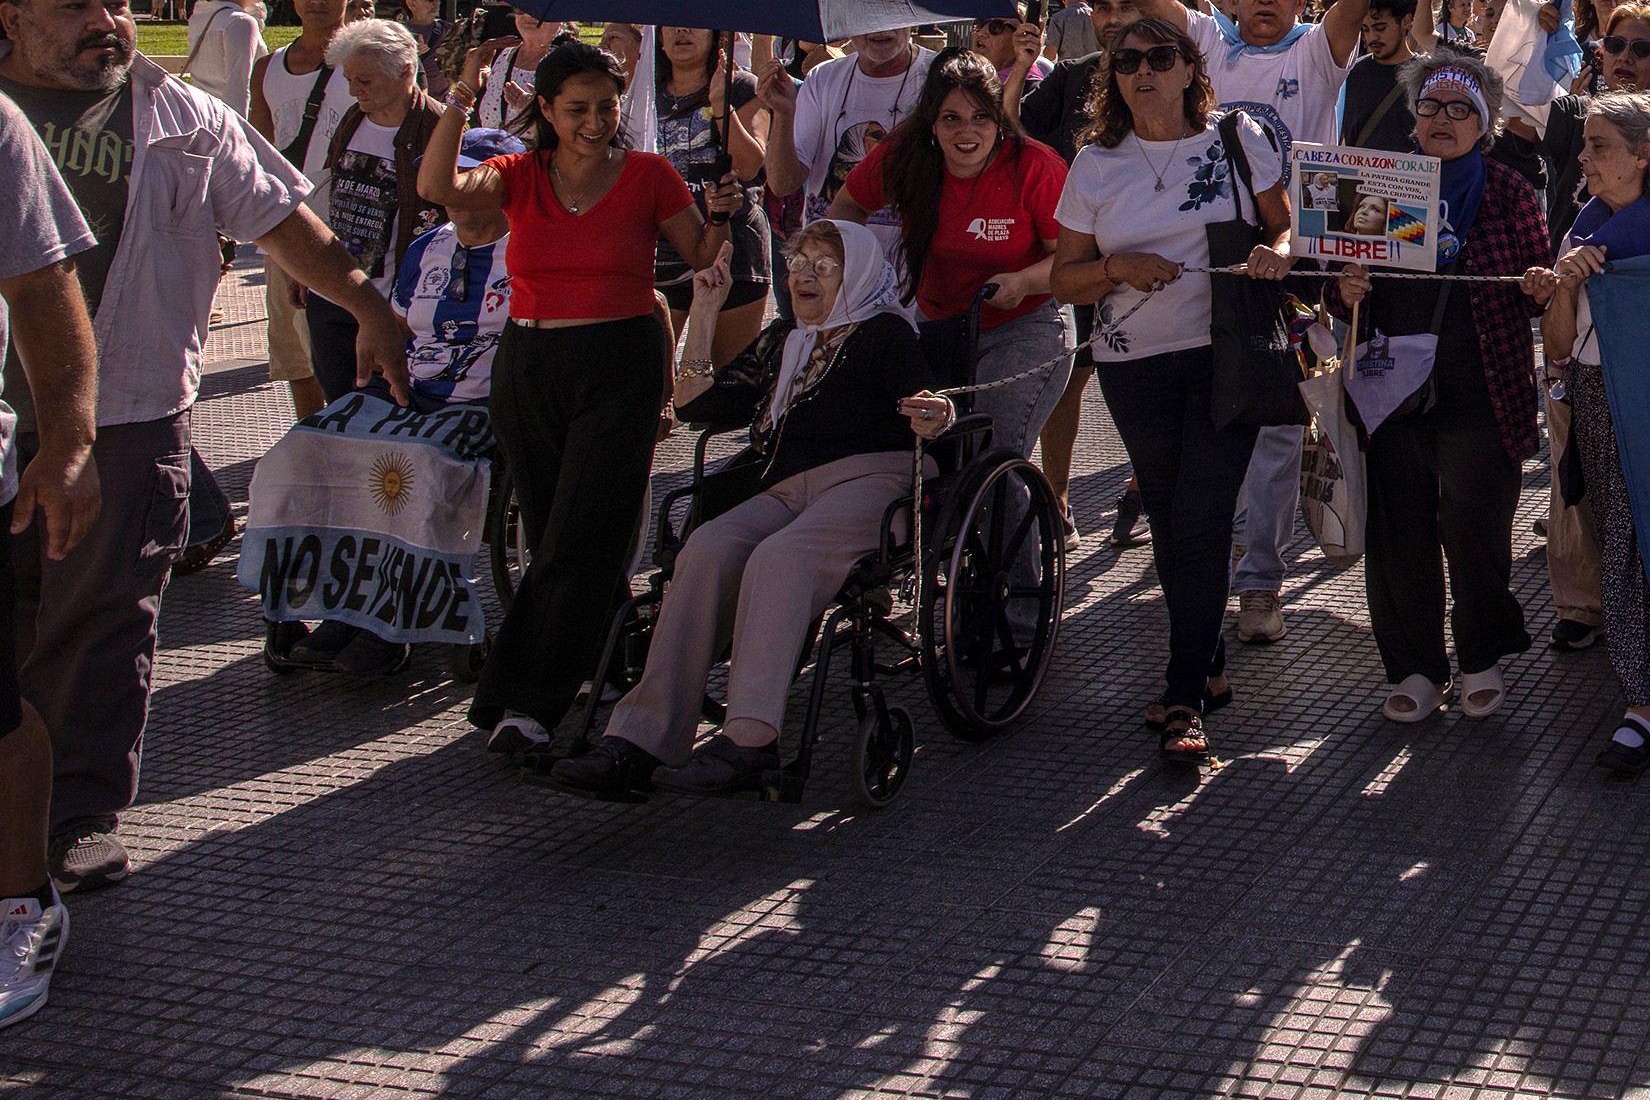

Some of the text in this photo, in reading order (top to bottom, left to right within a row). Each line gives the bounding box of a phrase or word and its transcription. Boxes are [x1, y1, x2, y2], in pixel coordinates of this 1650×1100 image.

[1341, 153, 1395, 170] CORAZON
[1395, 159, 1440, 174] CORAJE!
[1367, 180, 1387, 188] ESTA
[1405, 186, 1422, 194] VOS,
[1371, 173, 1399, 183] PATRIA
[1399, 177, 1432, 187] GRANDE
[344, 180, 355, 190] DE
[356, 183, 380, 197] MARZO
[1359, 186, 1428, 201] FUERZA CRISTINA!
[1357, 359, 1394, 369] CRISTINA
[1363, 369, 1384, 377] LIBRE
[369, 404, 497, 461] PATRI
[260, 534, 470, 632] NO SE VENDE
